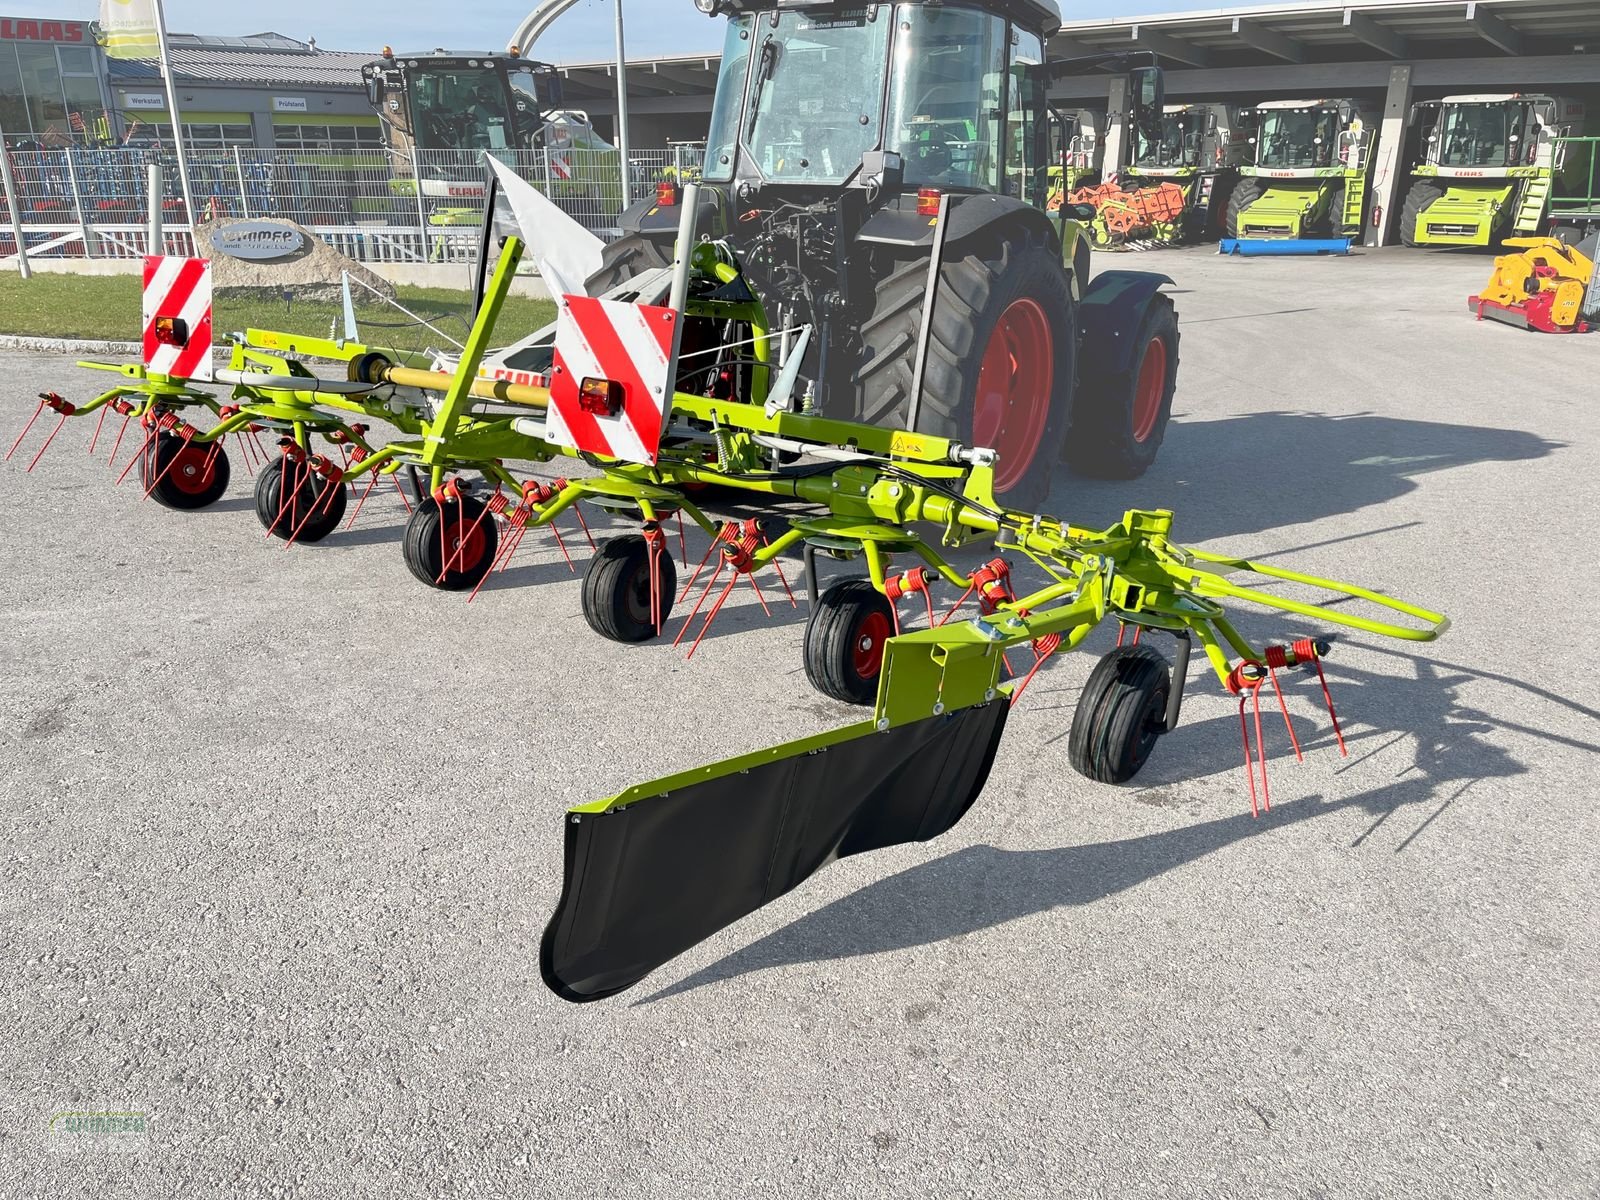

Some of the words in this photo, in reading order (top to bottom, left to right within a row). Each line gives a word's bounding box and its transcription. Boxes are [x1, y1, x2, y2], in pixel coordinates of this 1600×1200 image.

[131, 97, 161, 105] Werkstatt
[278, 100, 305, 108] Prüfstand
[495, 369, 552, 388] CLAA
